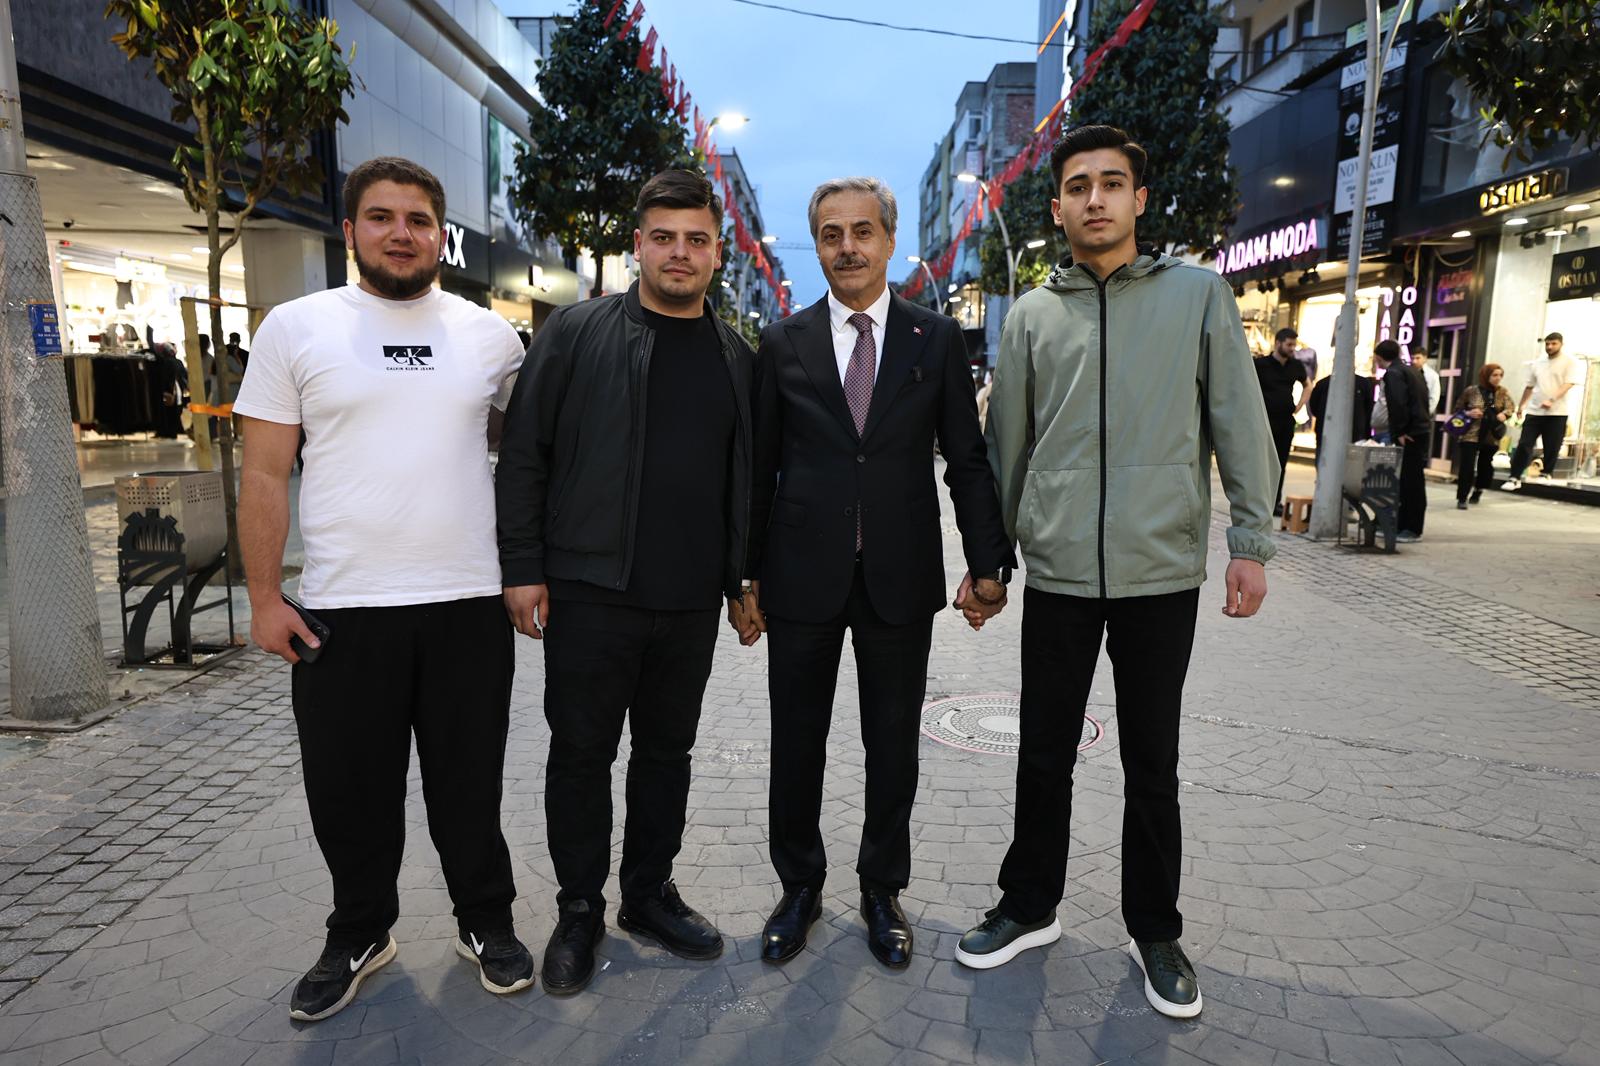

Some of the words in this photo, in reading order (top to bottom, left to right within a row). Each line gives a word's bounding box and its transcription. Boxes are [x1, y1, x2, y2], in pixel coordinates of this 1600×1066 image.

[1225, 234, 1268, 273] ADAM
[1269, 218, 1318, 262] MODA
[1557, 271, 1597, 288] OSMAN
[392, 347, 430, 366] CK
